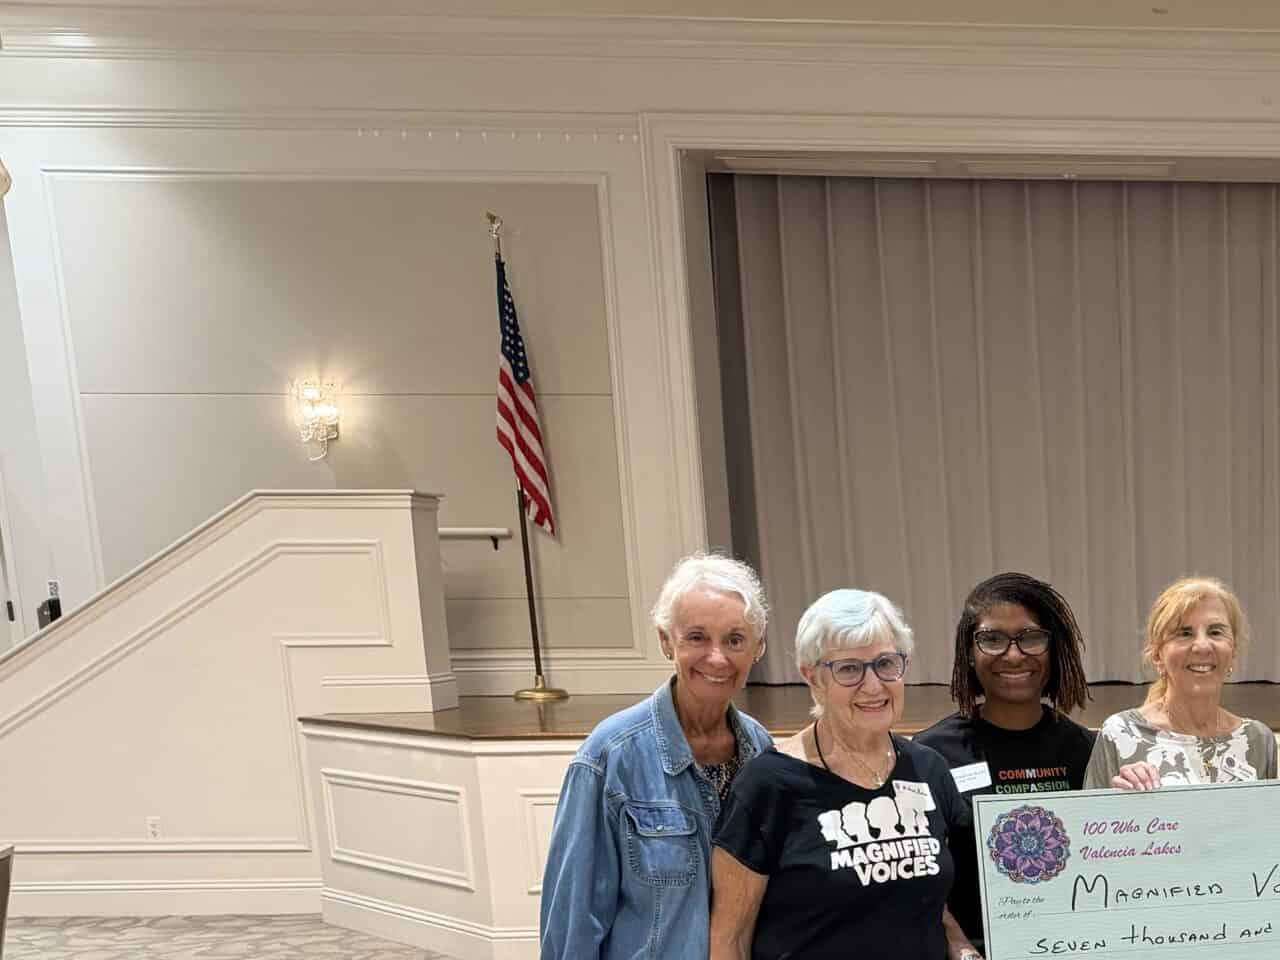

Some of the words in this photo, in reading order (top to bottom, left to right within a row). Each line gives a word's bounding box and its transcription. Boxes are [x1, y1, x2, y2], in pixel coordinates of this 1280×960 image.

[999, 767, 1066, 780] COMMUNITY
[996, 780, 1070, 793] COMPASSION
[1083, 822, 1107, 835] 100
[1111, 820, 1140, 834] Who
[1146, 817, 1179, 834] Care
[830, 838, 940, 870] MAGNIFIED
[1080, 845, 1136, 860] Valencia
[1141, 841, 1181, 856] Lakes
[854, 855, 940, 886] VOICES
